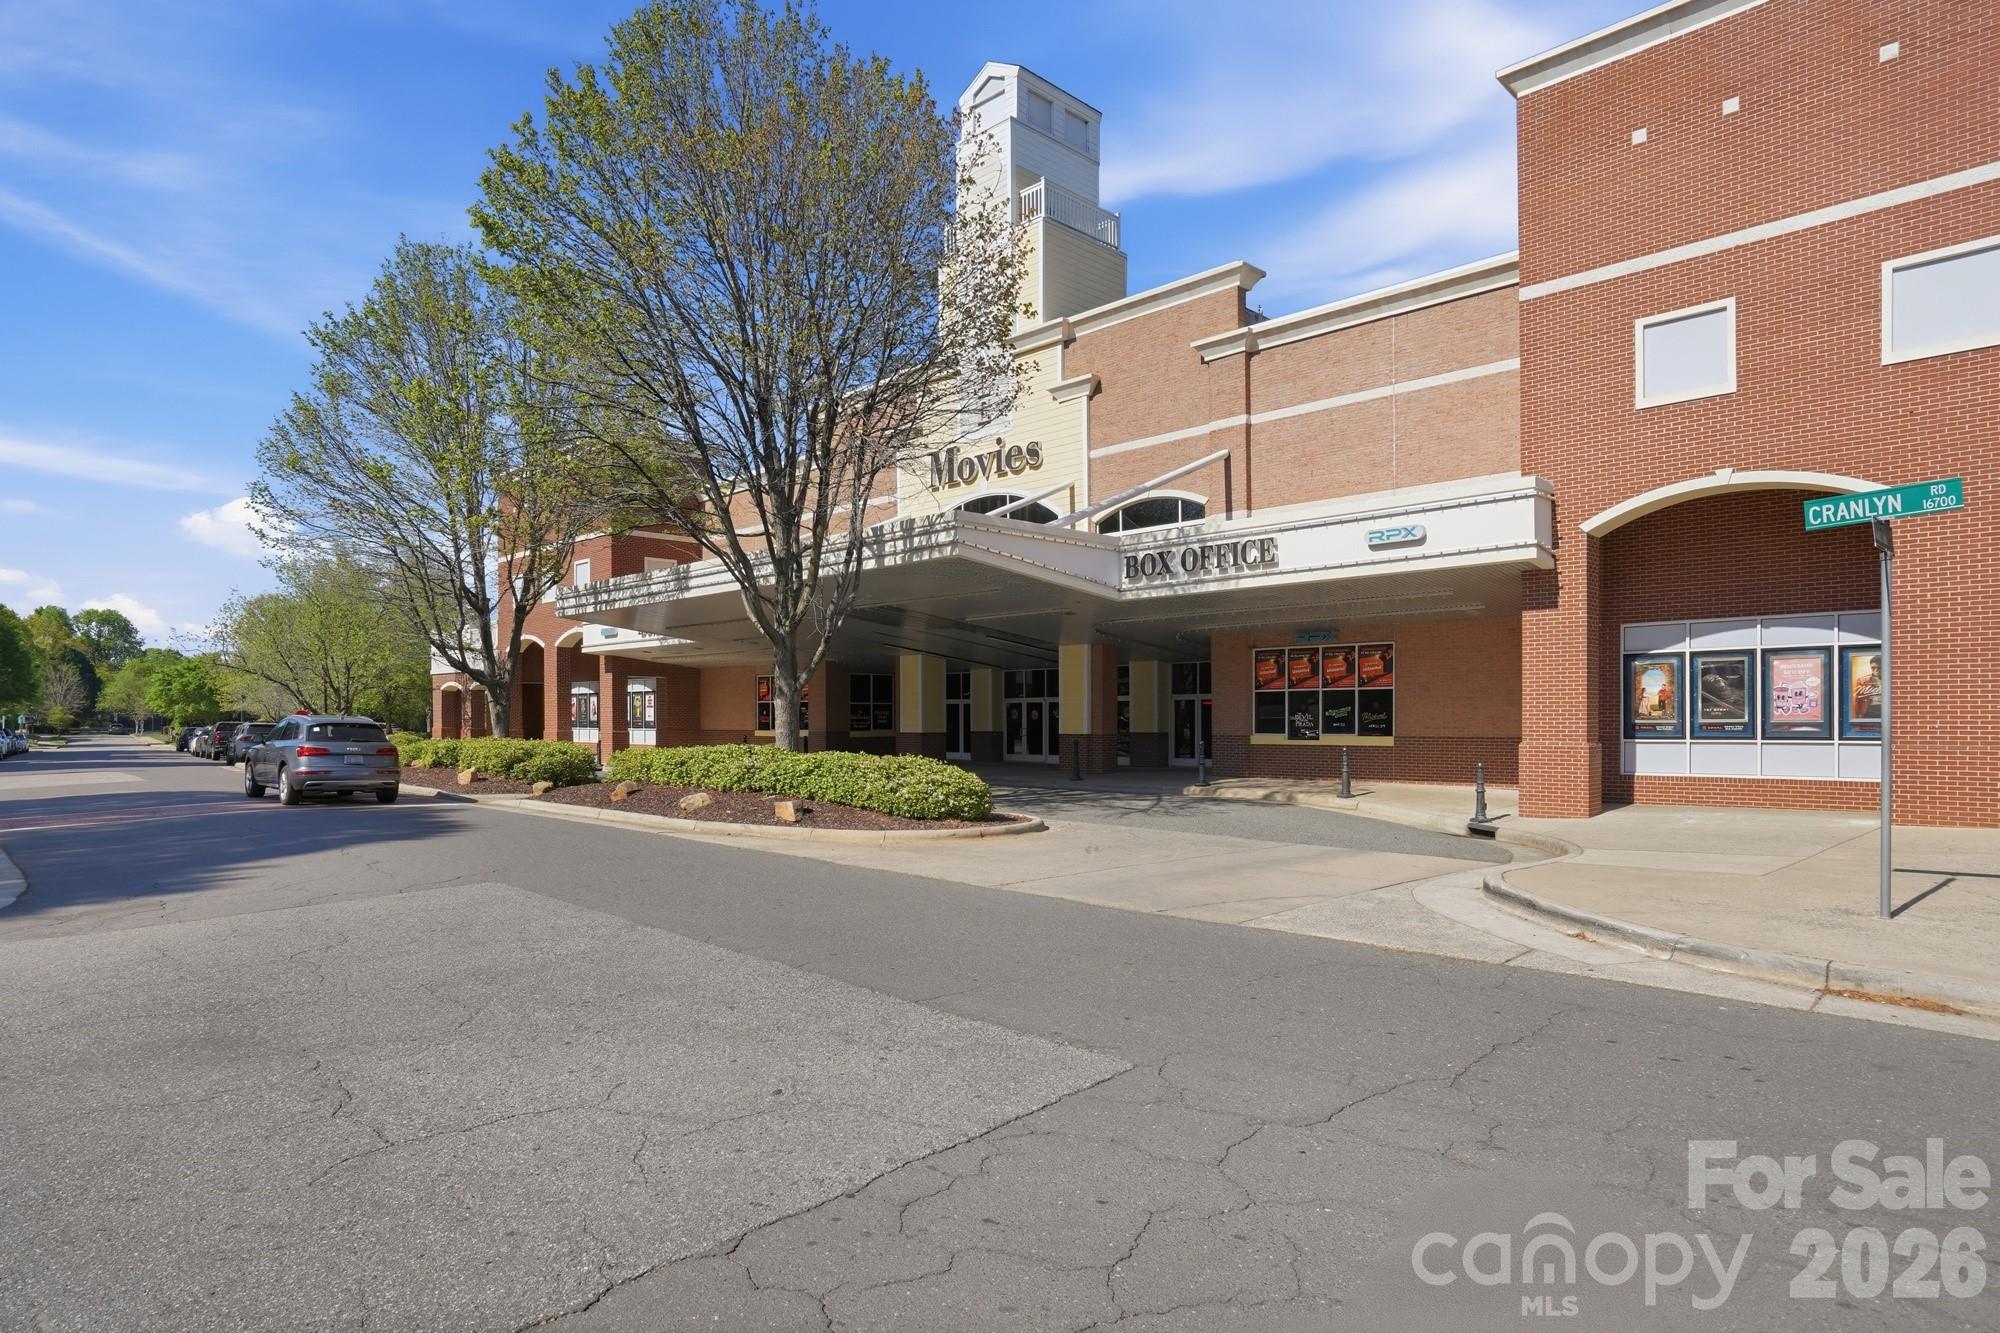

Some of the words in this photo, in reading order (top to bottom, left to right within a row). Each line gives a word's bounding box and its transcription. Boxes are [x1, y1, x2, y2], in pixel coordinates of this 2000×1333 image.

[929, 437, 1043, 491] Movies
[1930, 484, 1946, 496] RD
[1808, 493, 1902, 525] CRANLYN
[1923, 495, 1957, 510] 16700
[1368, 526, 1417, 543] RPX
[1124, 550, 1174, 579] BOX
[1180, 537, 1276, 572] OFFICE
